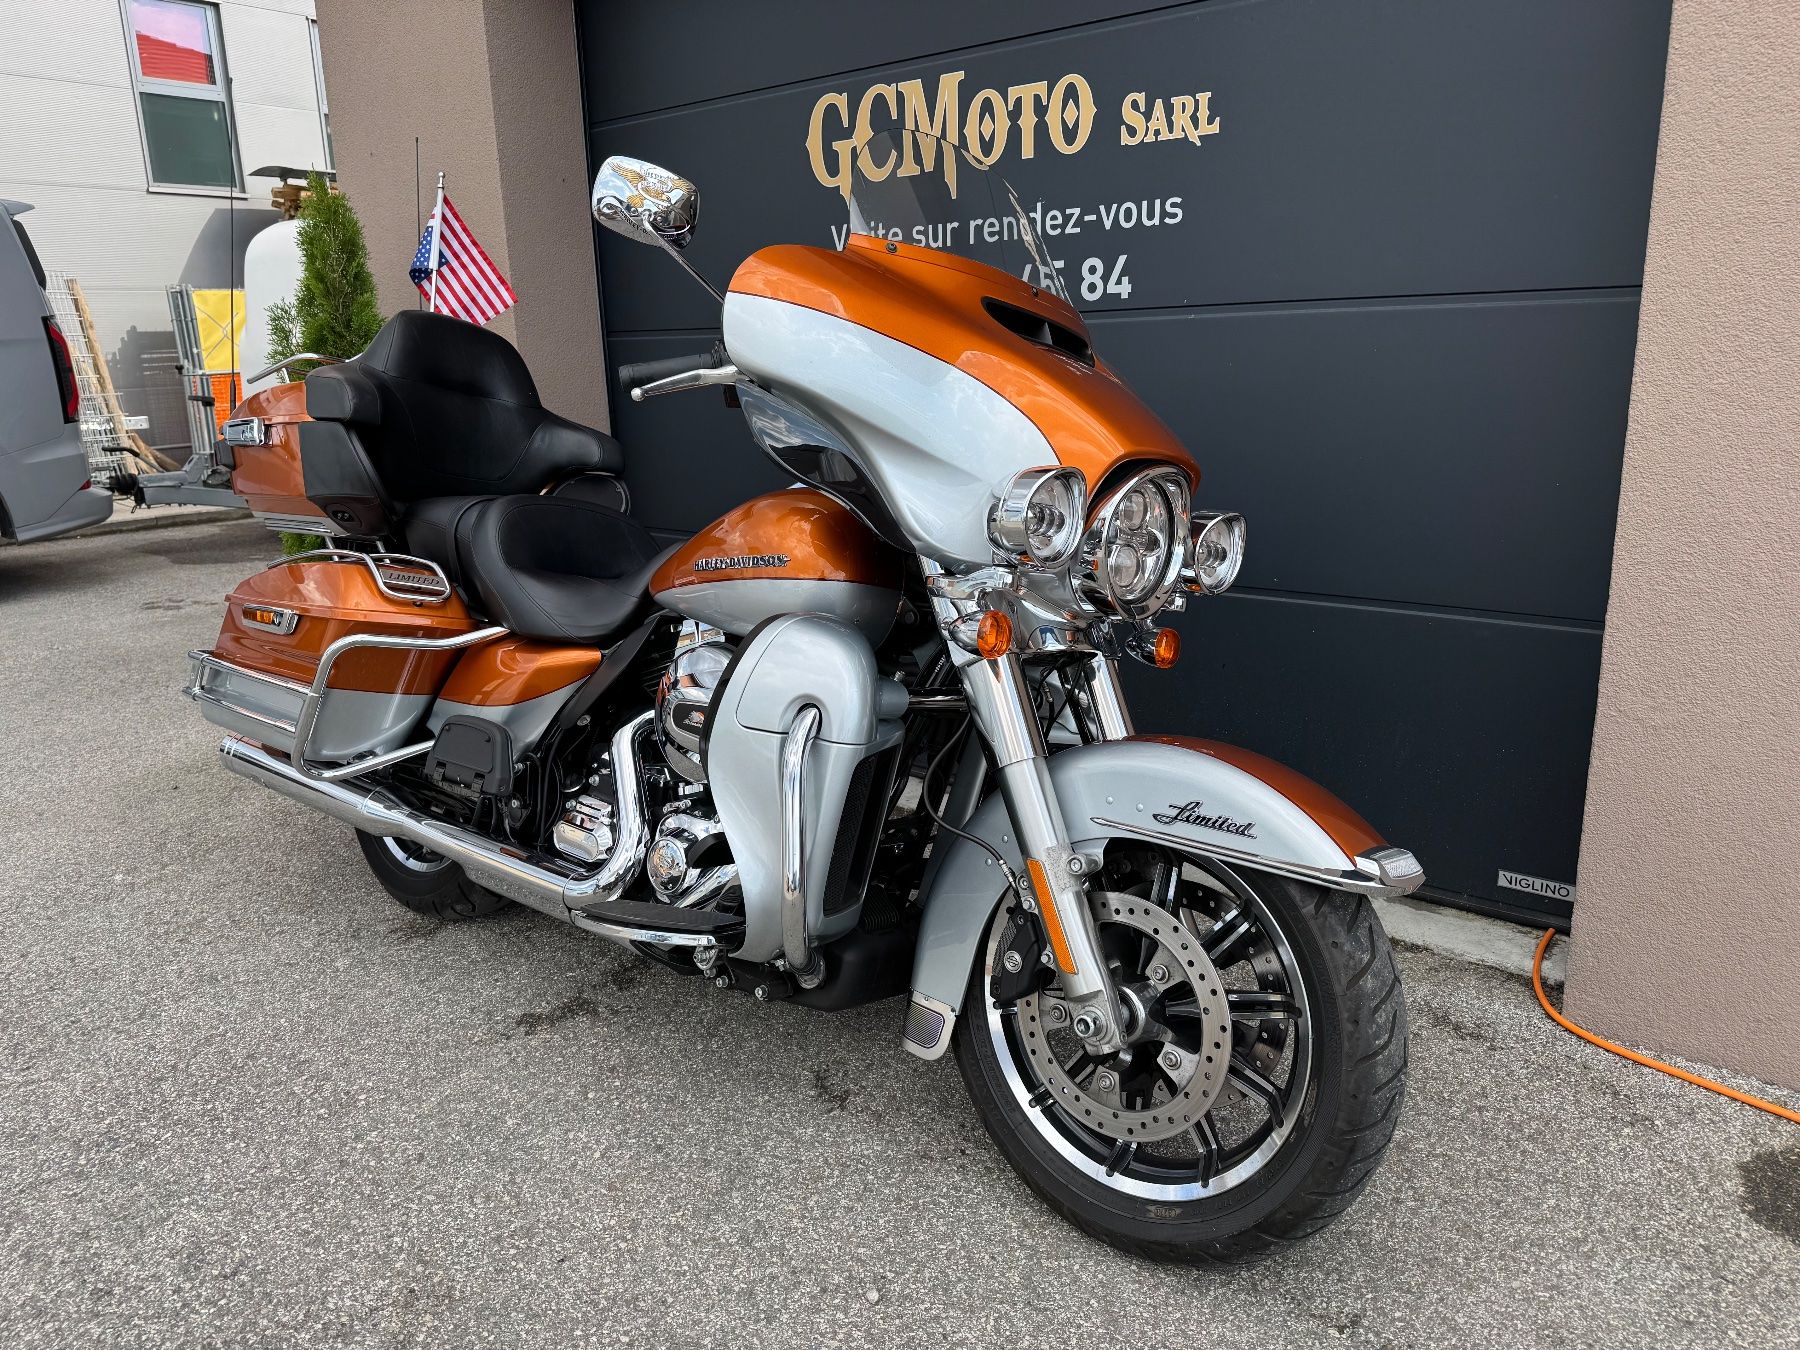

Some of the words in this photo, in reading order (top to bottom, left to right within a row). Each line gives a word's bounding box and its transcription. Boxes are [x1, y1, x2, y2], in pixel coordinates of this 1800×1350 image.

[830, 220, 904, 252] Vite
[912, 221, 960, 249] sur
[1080, 254, 1132, 301] 84
[388, 572, 441, 586] LIMITED
[1151, 800, 1258, 840] Limited
[1502, 873, 1570, 898] VIGLINO
